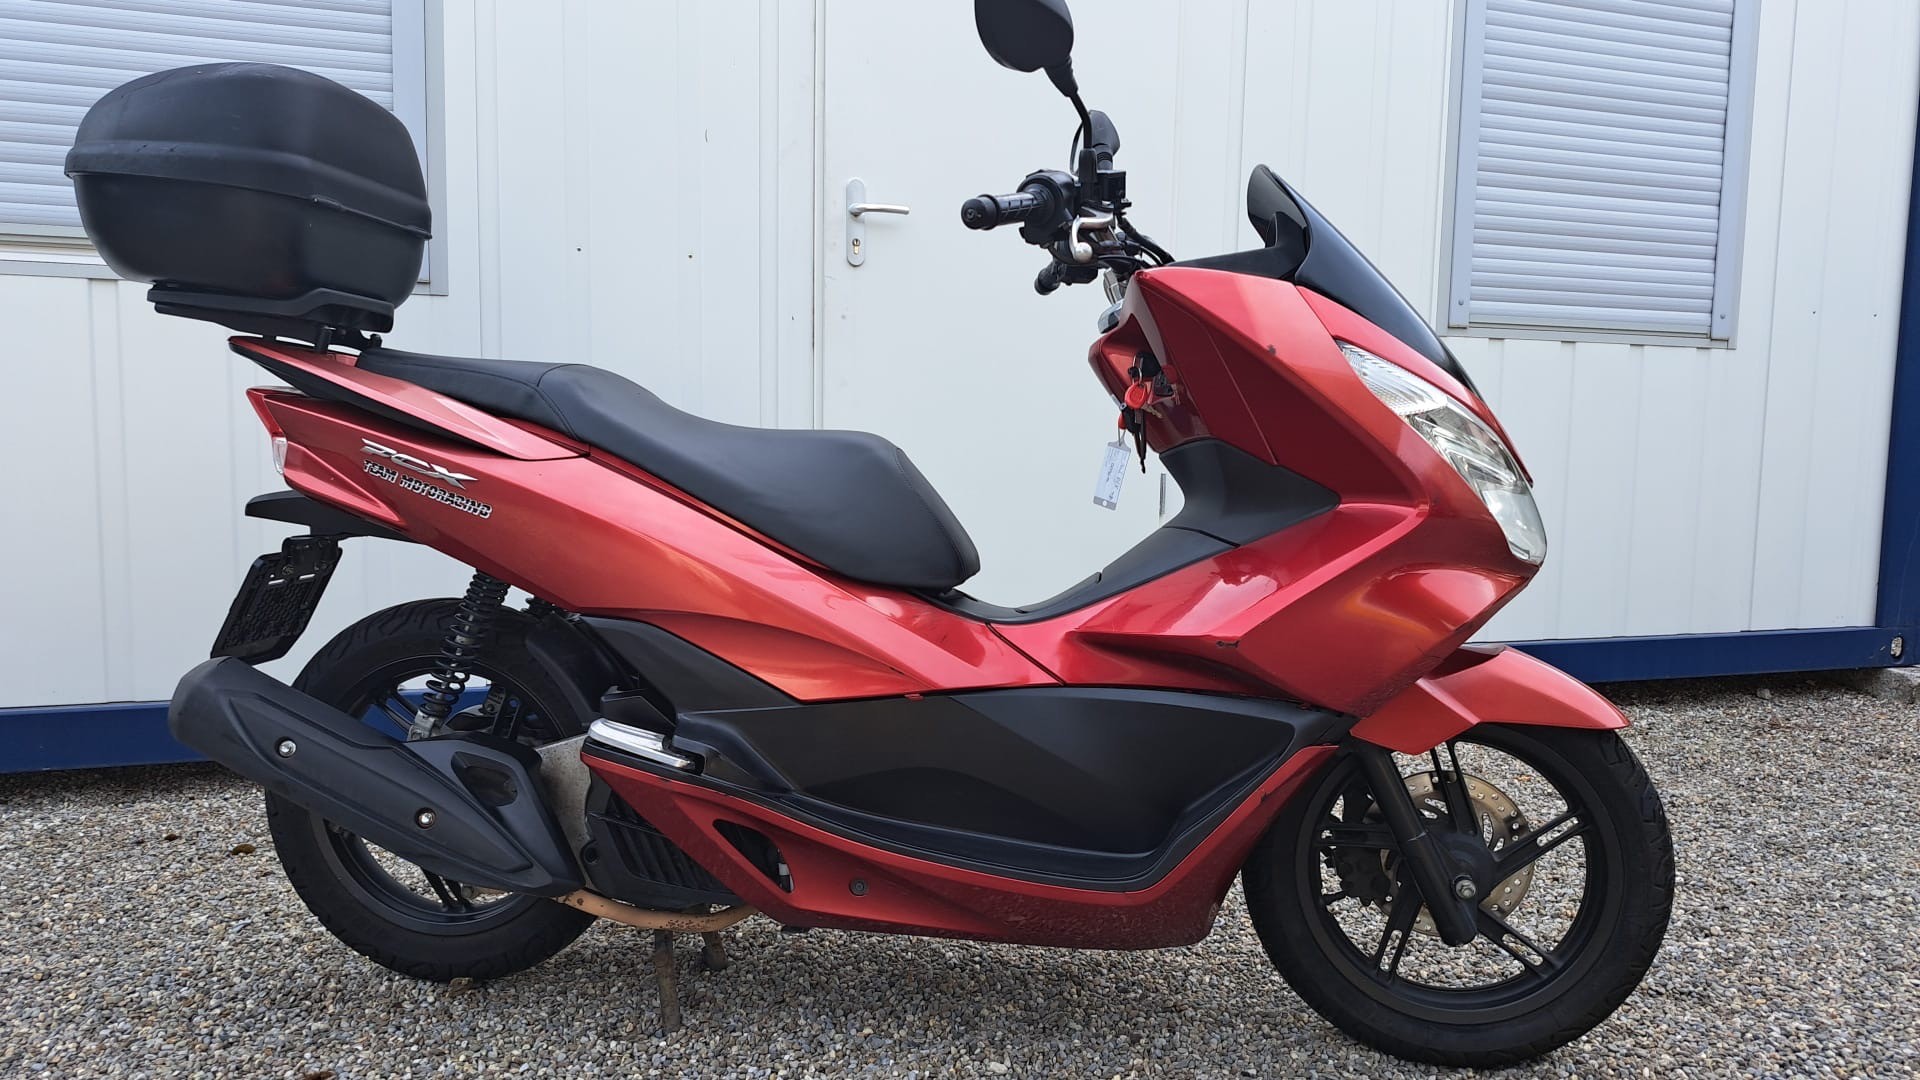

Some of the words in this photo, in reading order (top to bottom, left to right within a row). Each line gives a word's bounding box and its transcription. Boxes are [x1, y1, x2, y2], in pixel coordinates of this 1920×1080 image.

[360, 438, 478, 490] PCX
[363, 460, 399, 483] TEAM
[400, 475, 493, 519] MOTORACING
